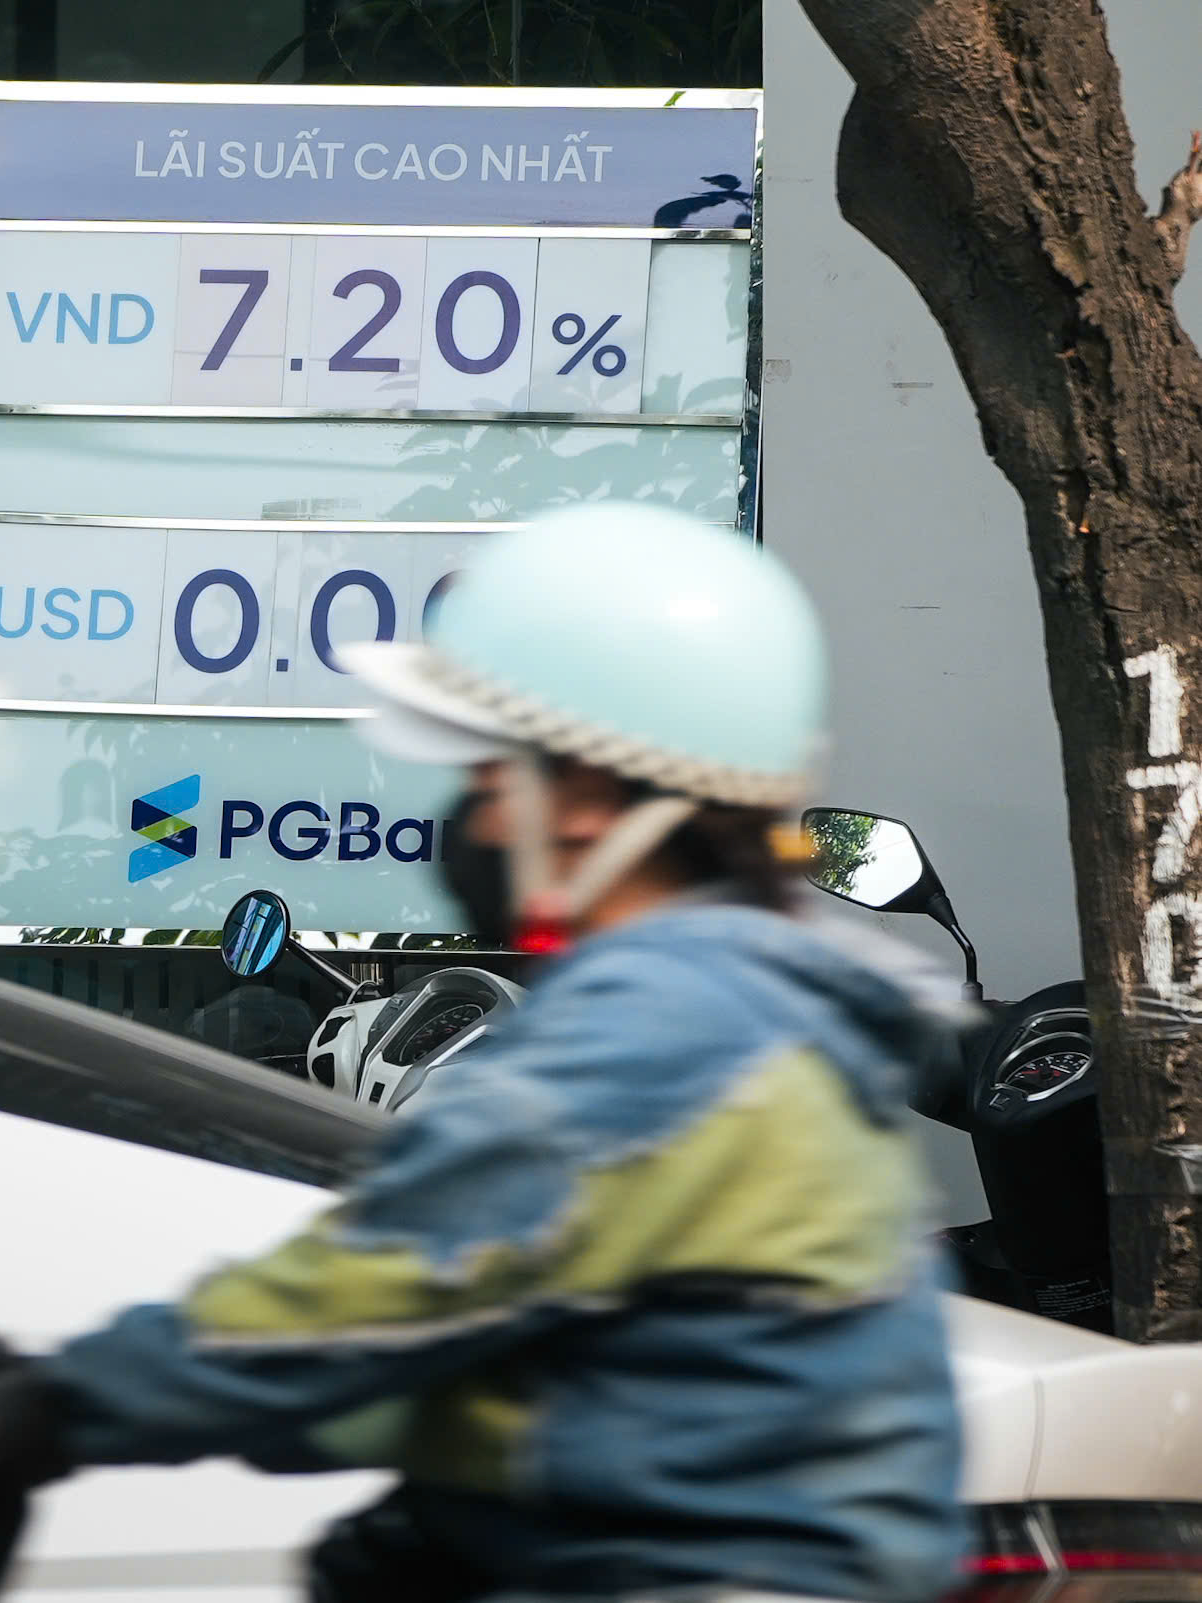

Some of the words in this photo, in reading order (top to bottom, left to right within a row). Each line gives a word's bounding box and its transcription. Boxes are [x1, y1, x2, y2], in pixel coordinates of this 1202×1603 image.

[135, 128, 206, 178] LÃI
[217, 127, 345, 180] SUẤT
[354, 142, 468, 181] CAO
[481, 130, 613, 183] NHẤT
[6, 291, 155, 344] VND
[219, 799, 453, 863] PGBa
